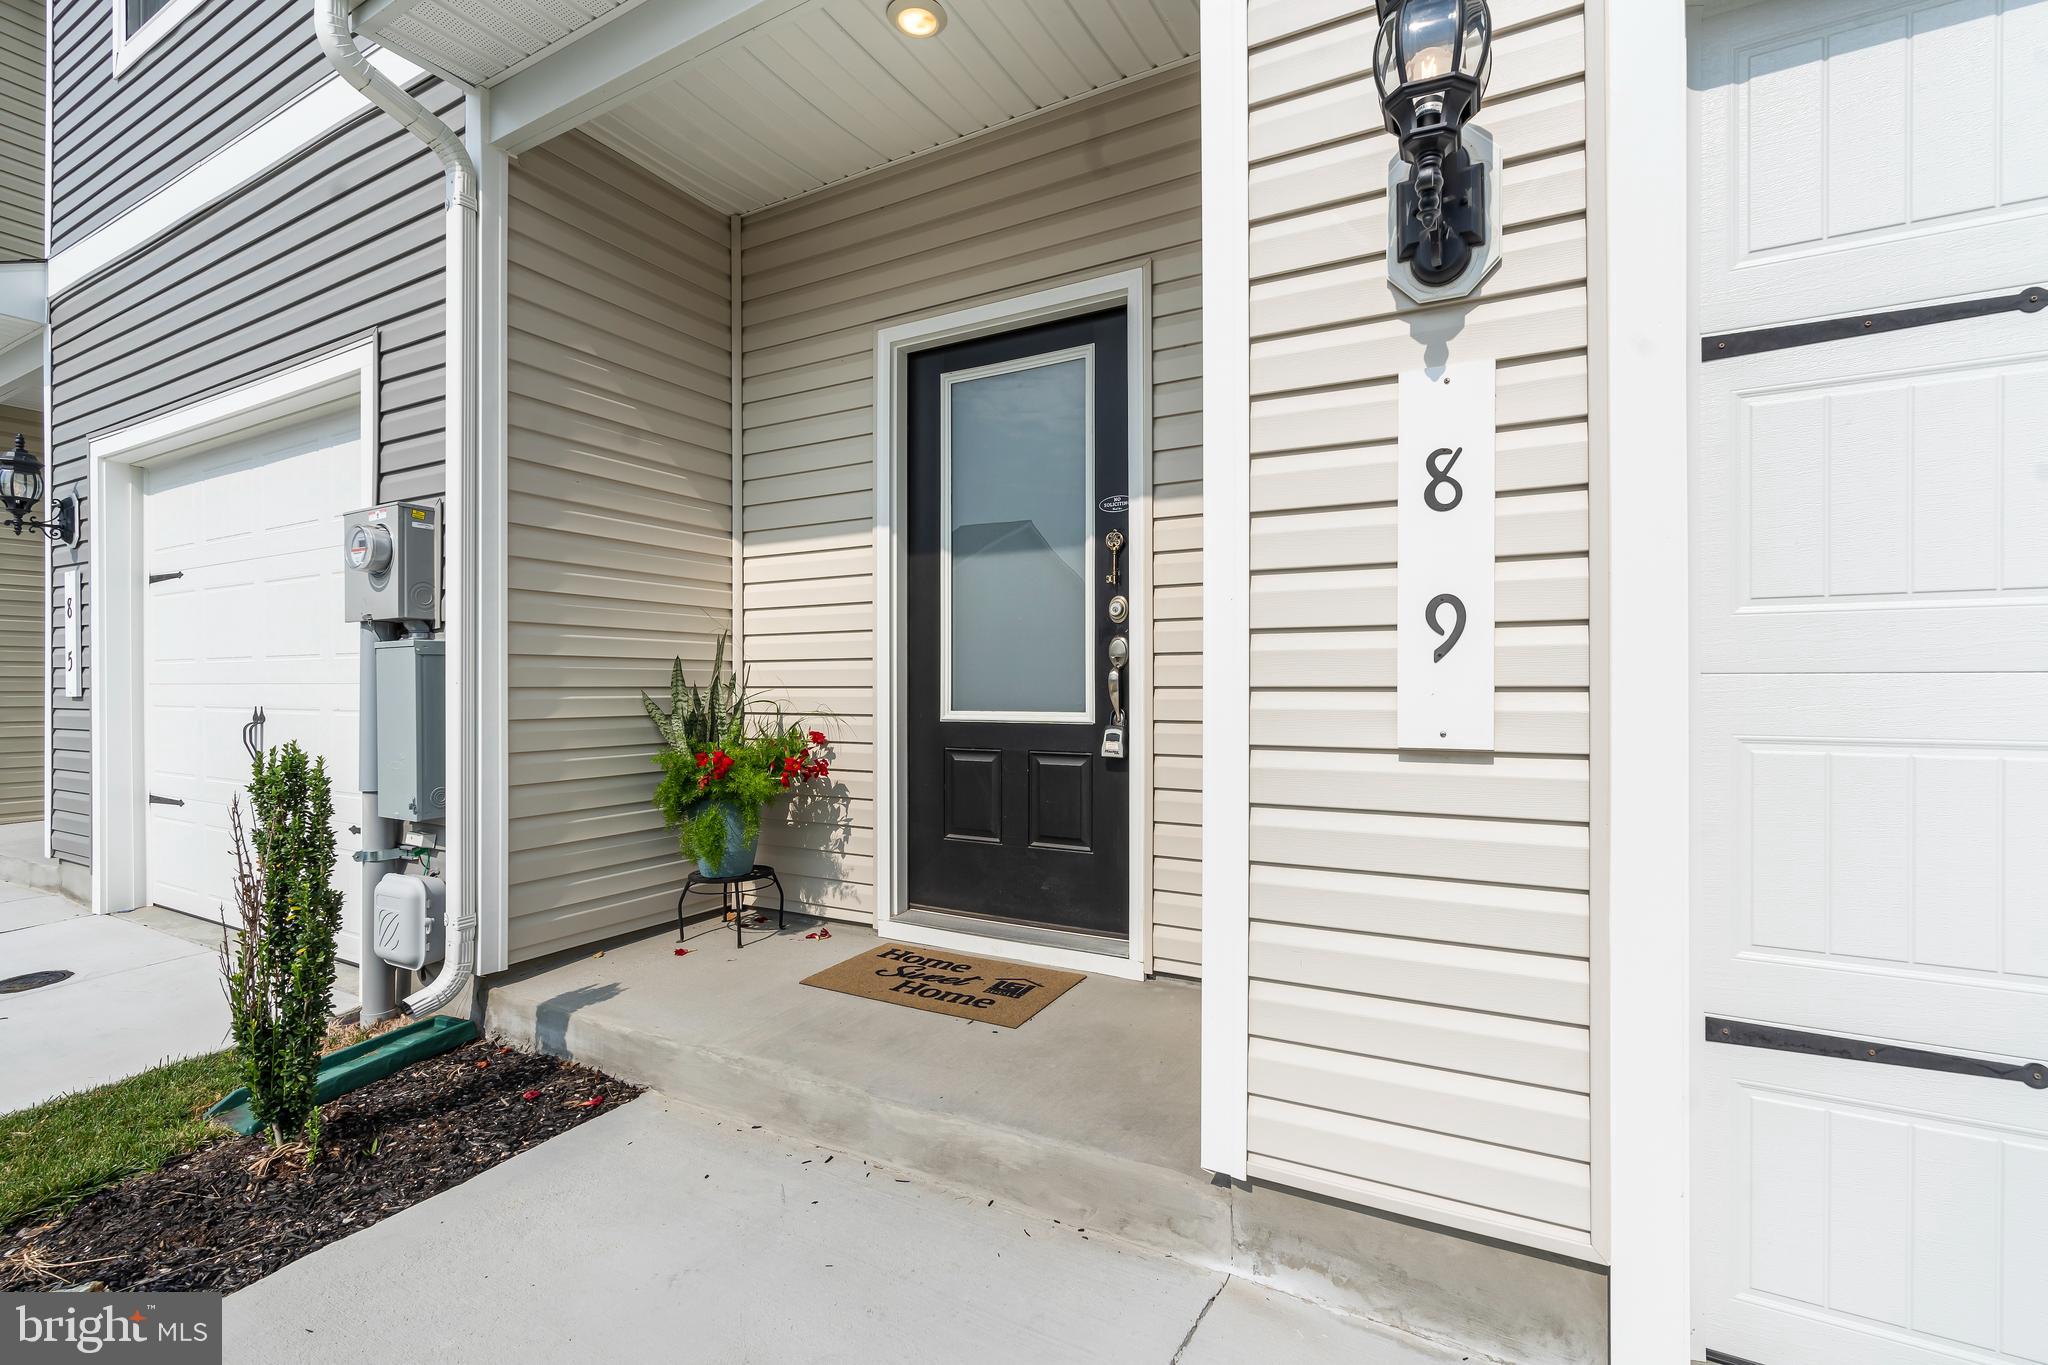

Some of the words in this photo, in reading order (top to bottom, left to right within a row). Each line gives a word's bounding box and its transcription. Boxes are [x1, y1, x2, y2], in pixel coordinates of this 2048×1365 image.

[1424, 447, 1463, 512] 8
[1425, 593, 1467, 664] 9
[875, 965, 984, 986] Sweet
[876, 948, 973, 973] Home
[889, 979, 997, 1009] Home
